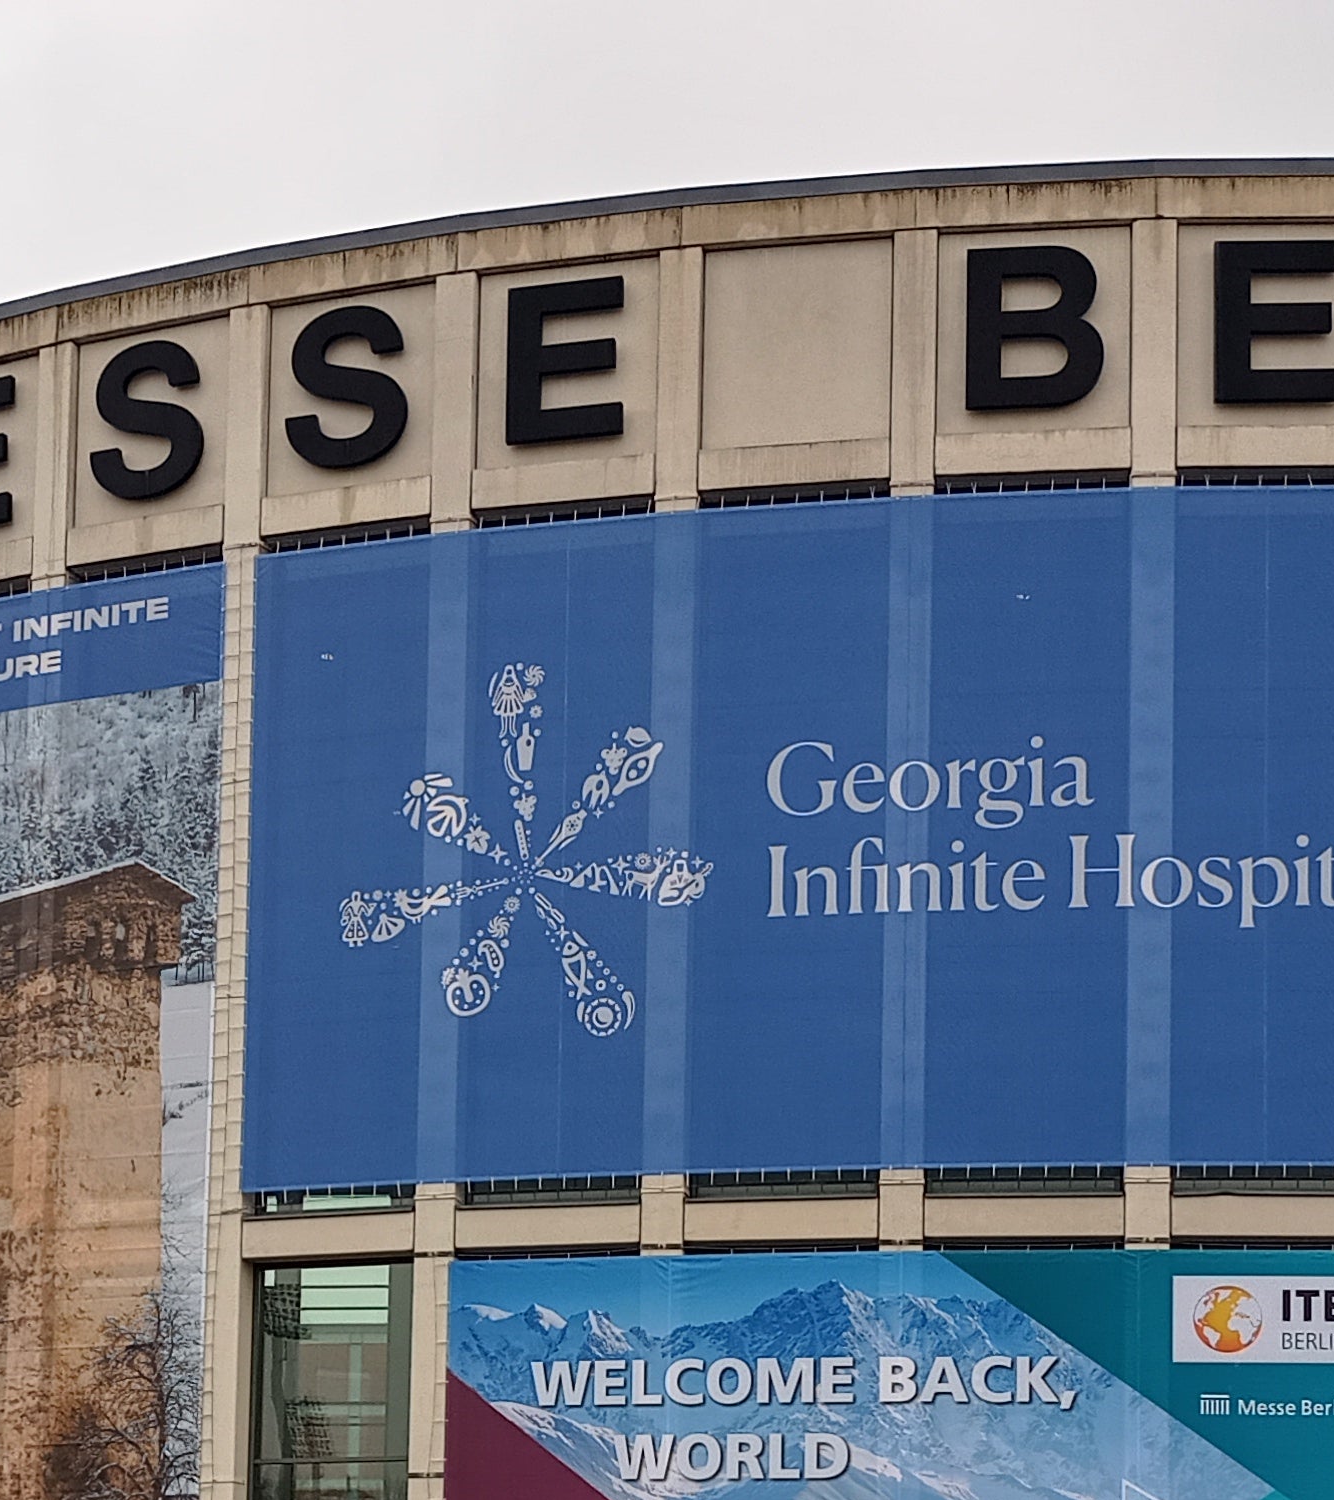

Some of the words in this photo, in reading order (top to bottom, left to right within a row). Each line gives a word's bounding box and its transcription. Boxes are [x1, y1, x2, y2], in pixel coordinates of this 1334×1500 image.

[14, 597, 169, 642] INFINITE
[766, 735, 1096, 830] Georgia
[767, 836, 1046, 918] Infinite
[531, 1356, 855, 1407] WELCOME
[879, 1356, 1078, 1410] BACK,
[1238, 1400, 1296, 1416] Messe
[614, 1432, 852, 1482] WORLD
